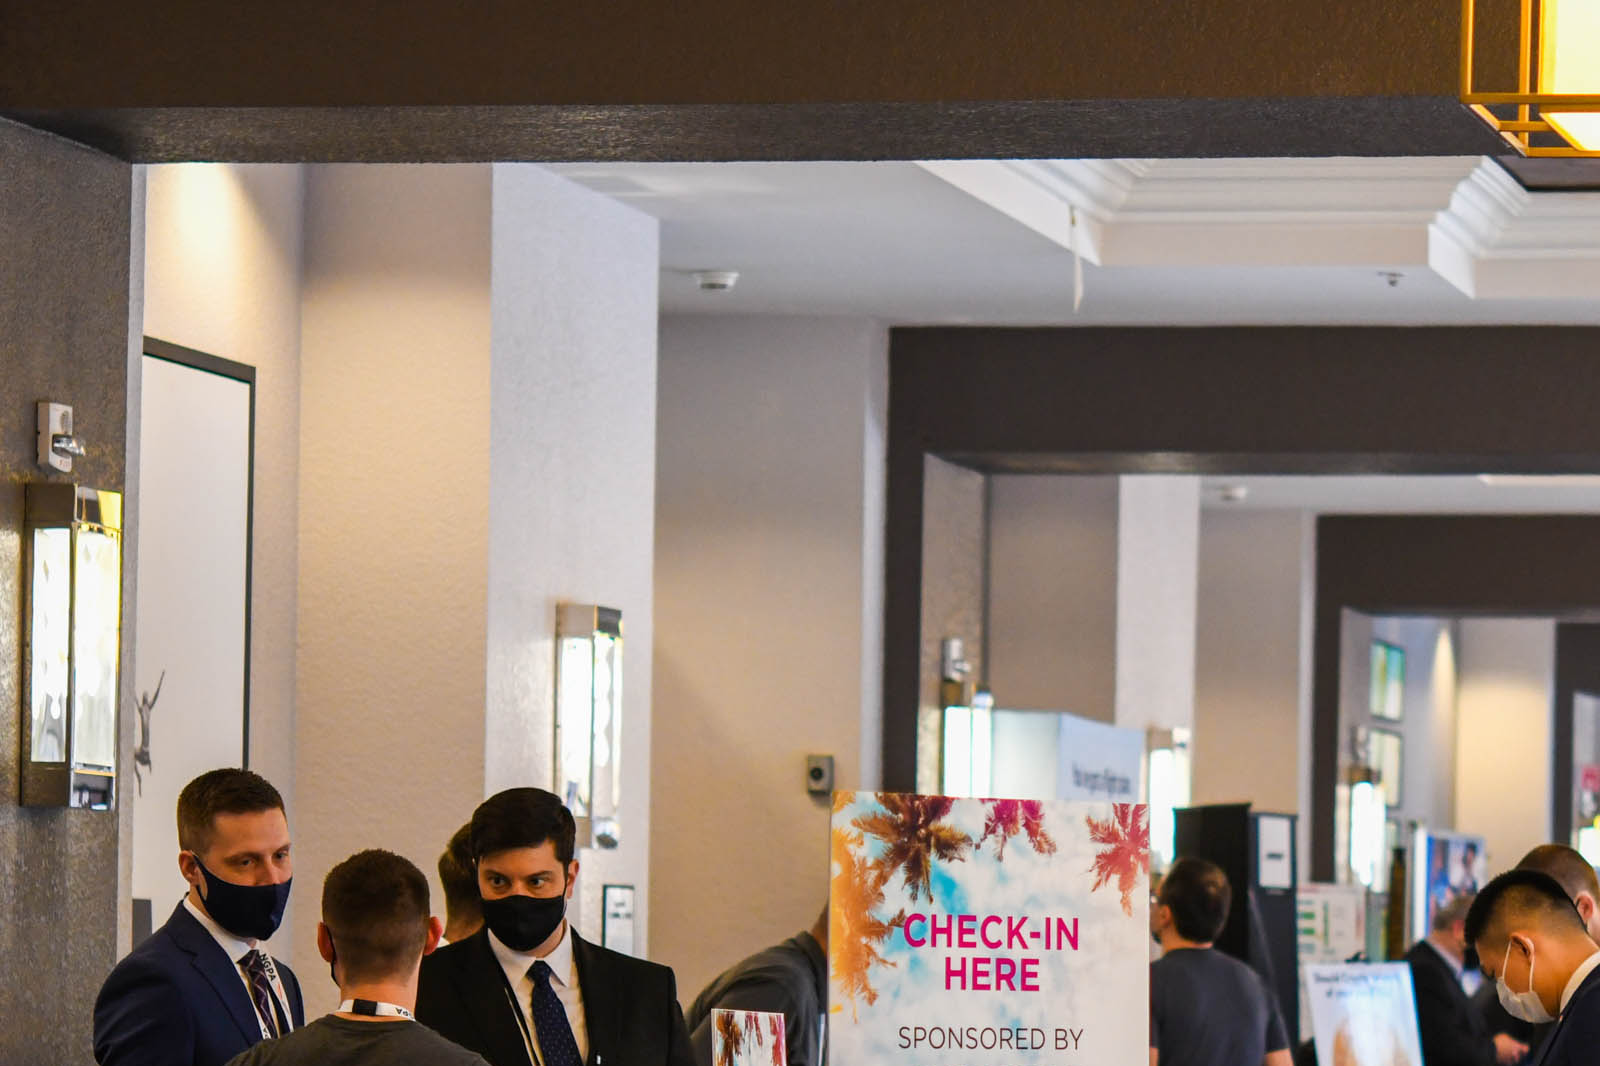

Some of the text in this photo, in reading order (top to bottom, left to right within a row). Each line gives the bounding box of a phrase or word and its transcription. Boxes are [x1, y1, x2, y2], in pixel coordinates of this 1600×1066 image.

[903, 913, 1079, 950] CHECK-IN
[945, 956, 1040, 992] HERE
[898, 1026, 1083, 1050] SPONSORED BY
